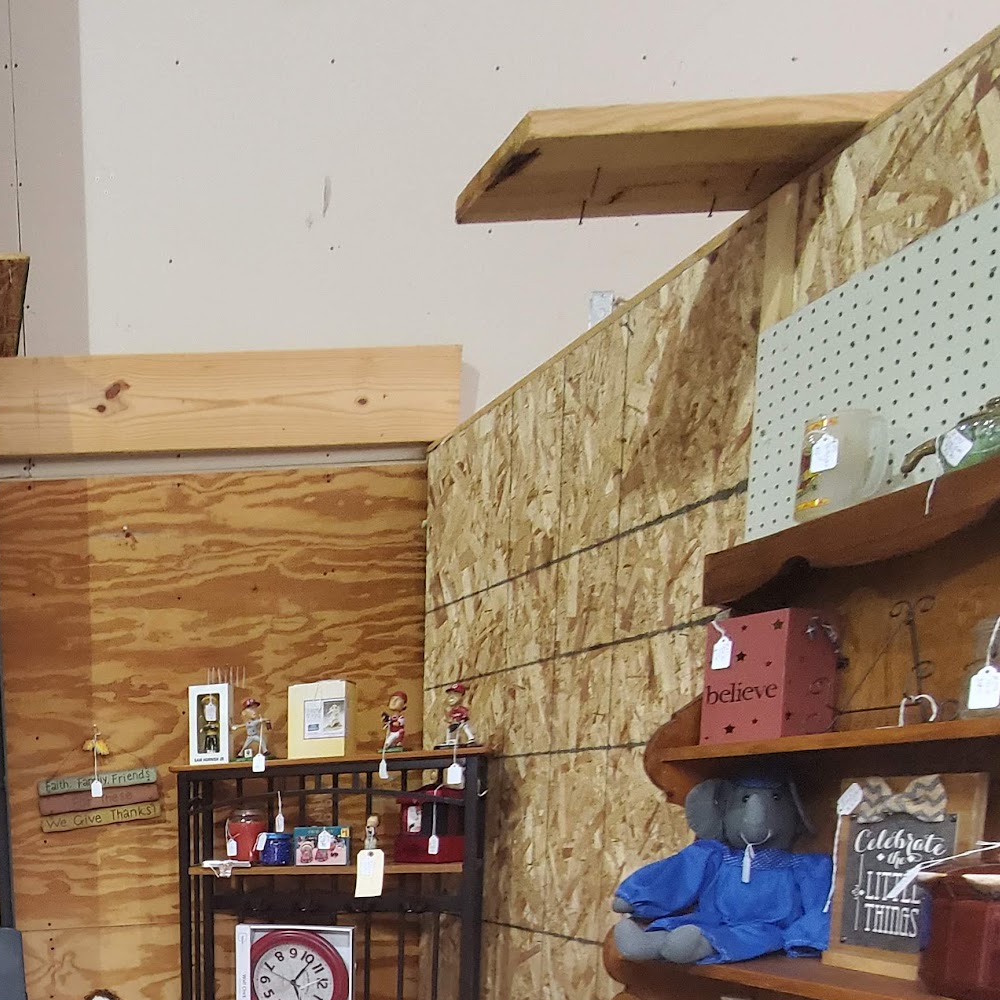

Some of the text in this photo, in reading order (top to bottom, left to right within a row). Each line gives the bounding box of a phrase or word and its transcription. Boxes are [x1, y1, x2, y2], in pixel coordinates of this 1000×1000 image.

[706, 682, 778, 705] believe
[46, 818, 67, 829] We
[73, 813, 102, 826] Give
[854, 828, 947, 857] Celebrate
[886, 851, 906, 869] the
[863, 903, 920, 938] THINGS
[274, 951, 285, 962] 8
[289, 948, 298, 958] 9
[300, 951, 315, 964] 10
[264, 962, 275, 972] 7
[312, 963, 325, 974] 11
[260, 975, 271, 984] 6
[316, 978, 328, 989] 12
[263, 989, 275, 998] 5
